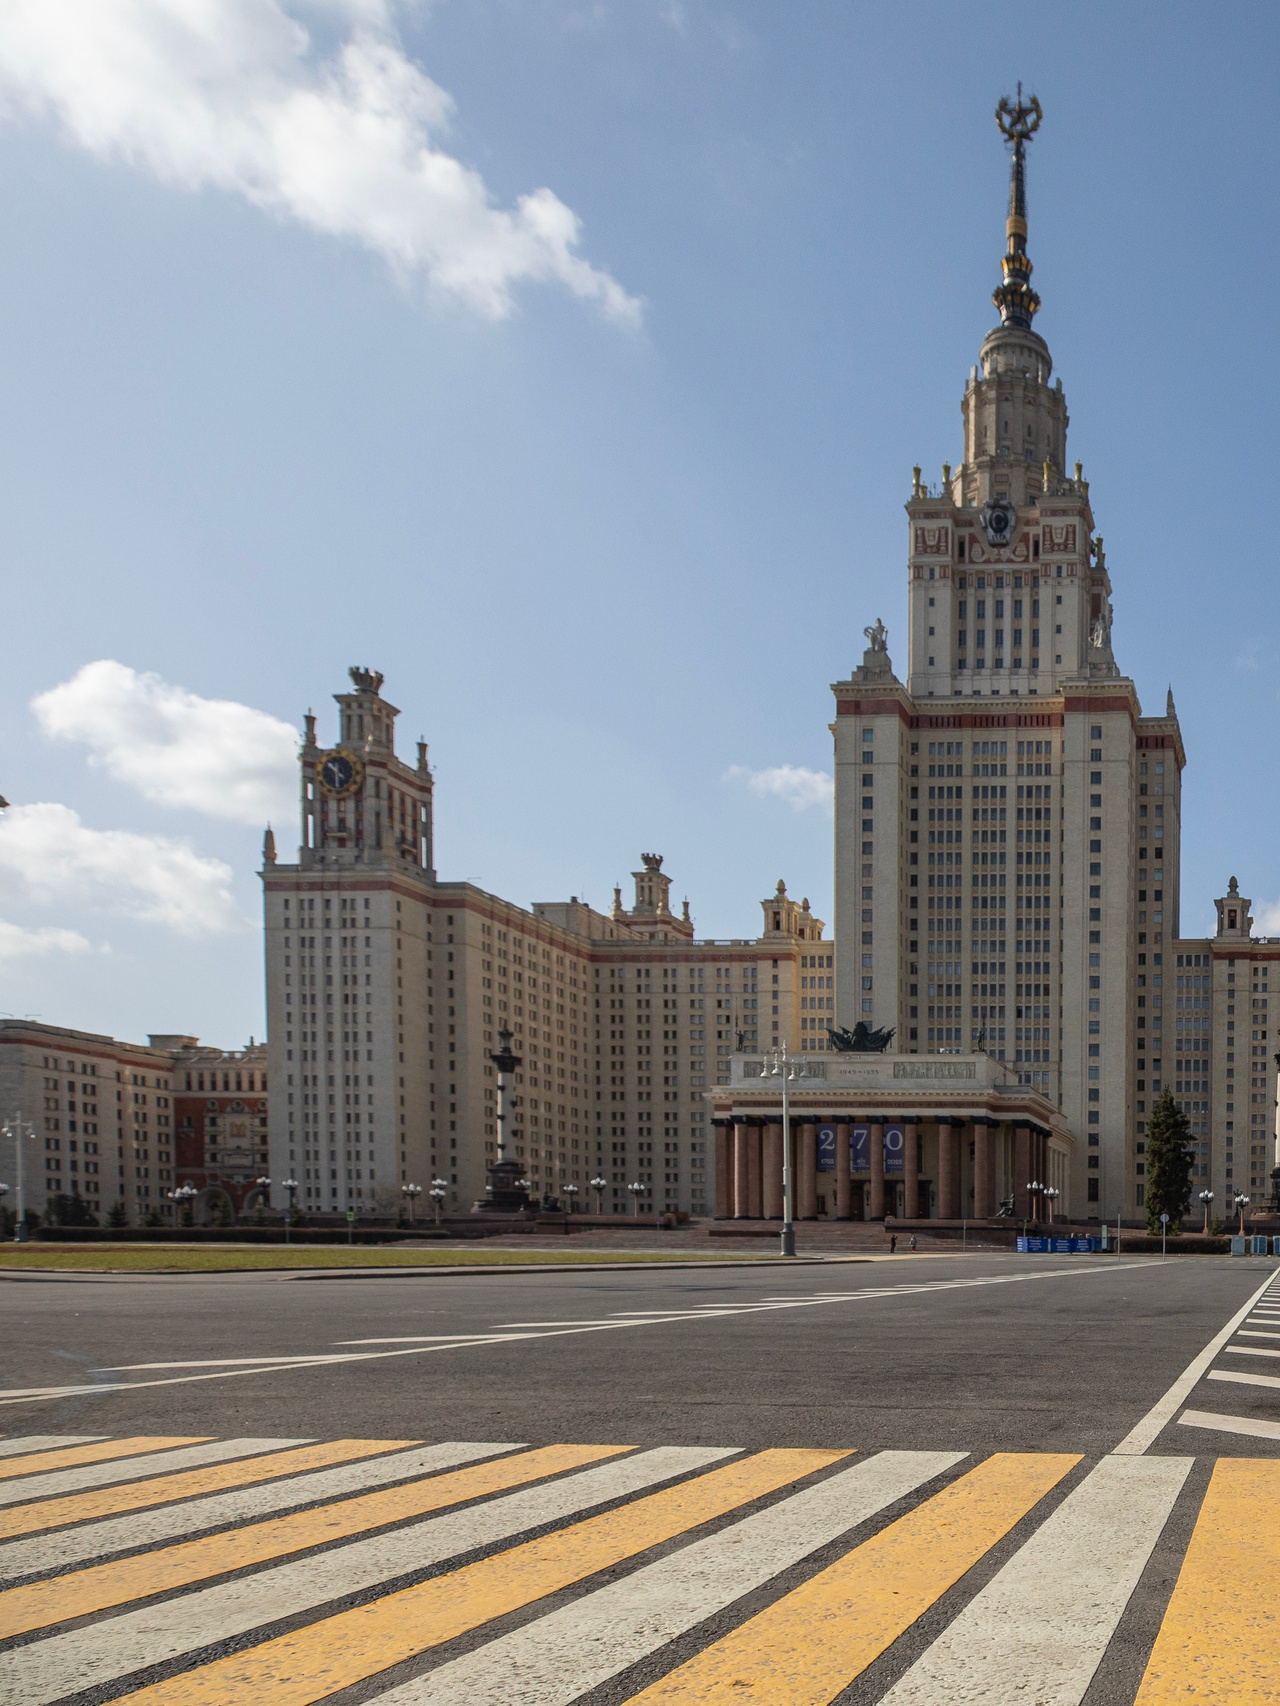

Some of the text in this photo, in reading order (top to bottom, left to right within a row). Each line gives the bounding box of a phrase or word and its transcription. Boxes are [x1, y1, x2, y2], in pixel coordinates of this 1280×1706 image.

[820, 1130, 904, 1151] 2 7 0
